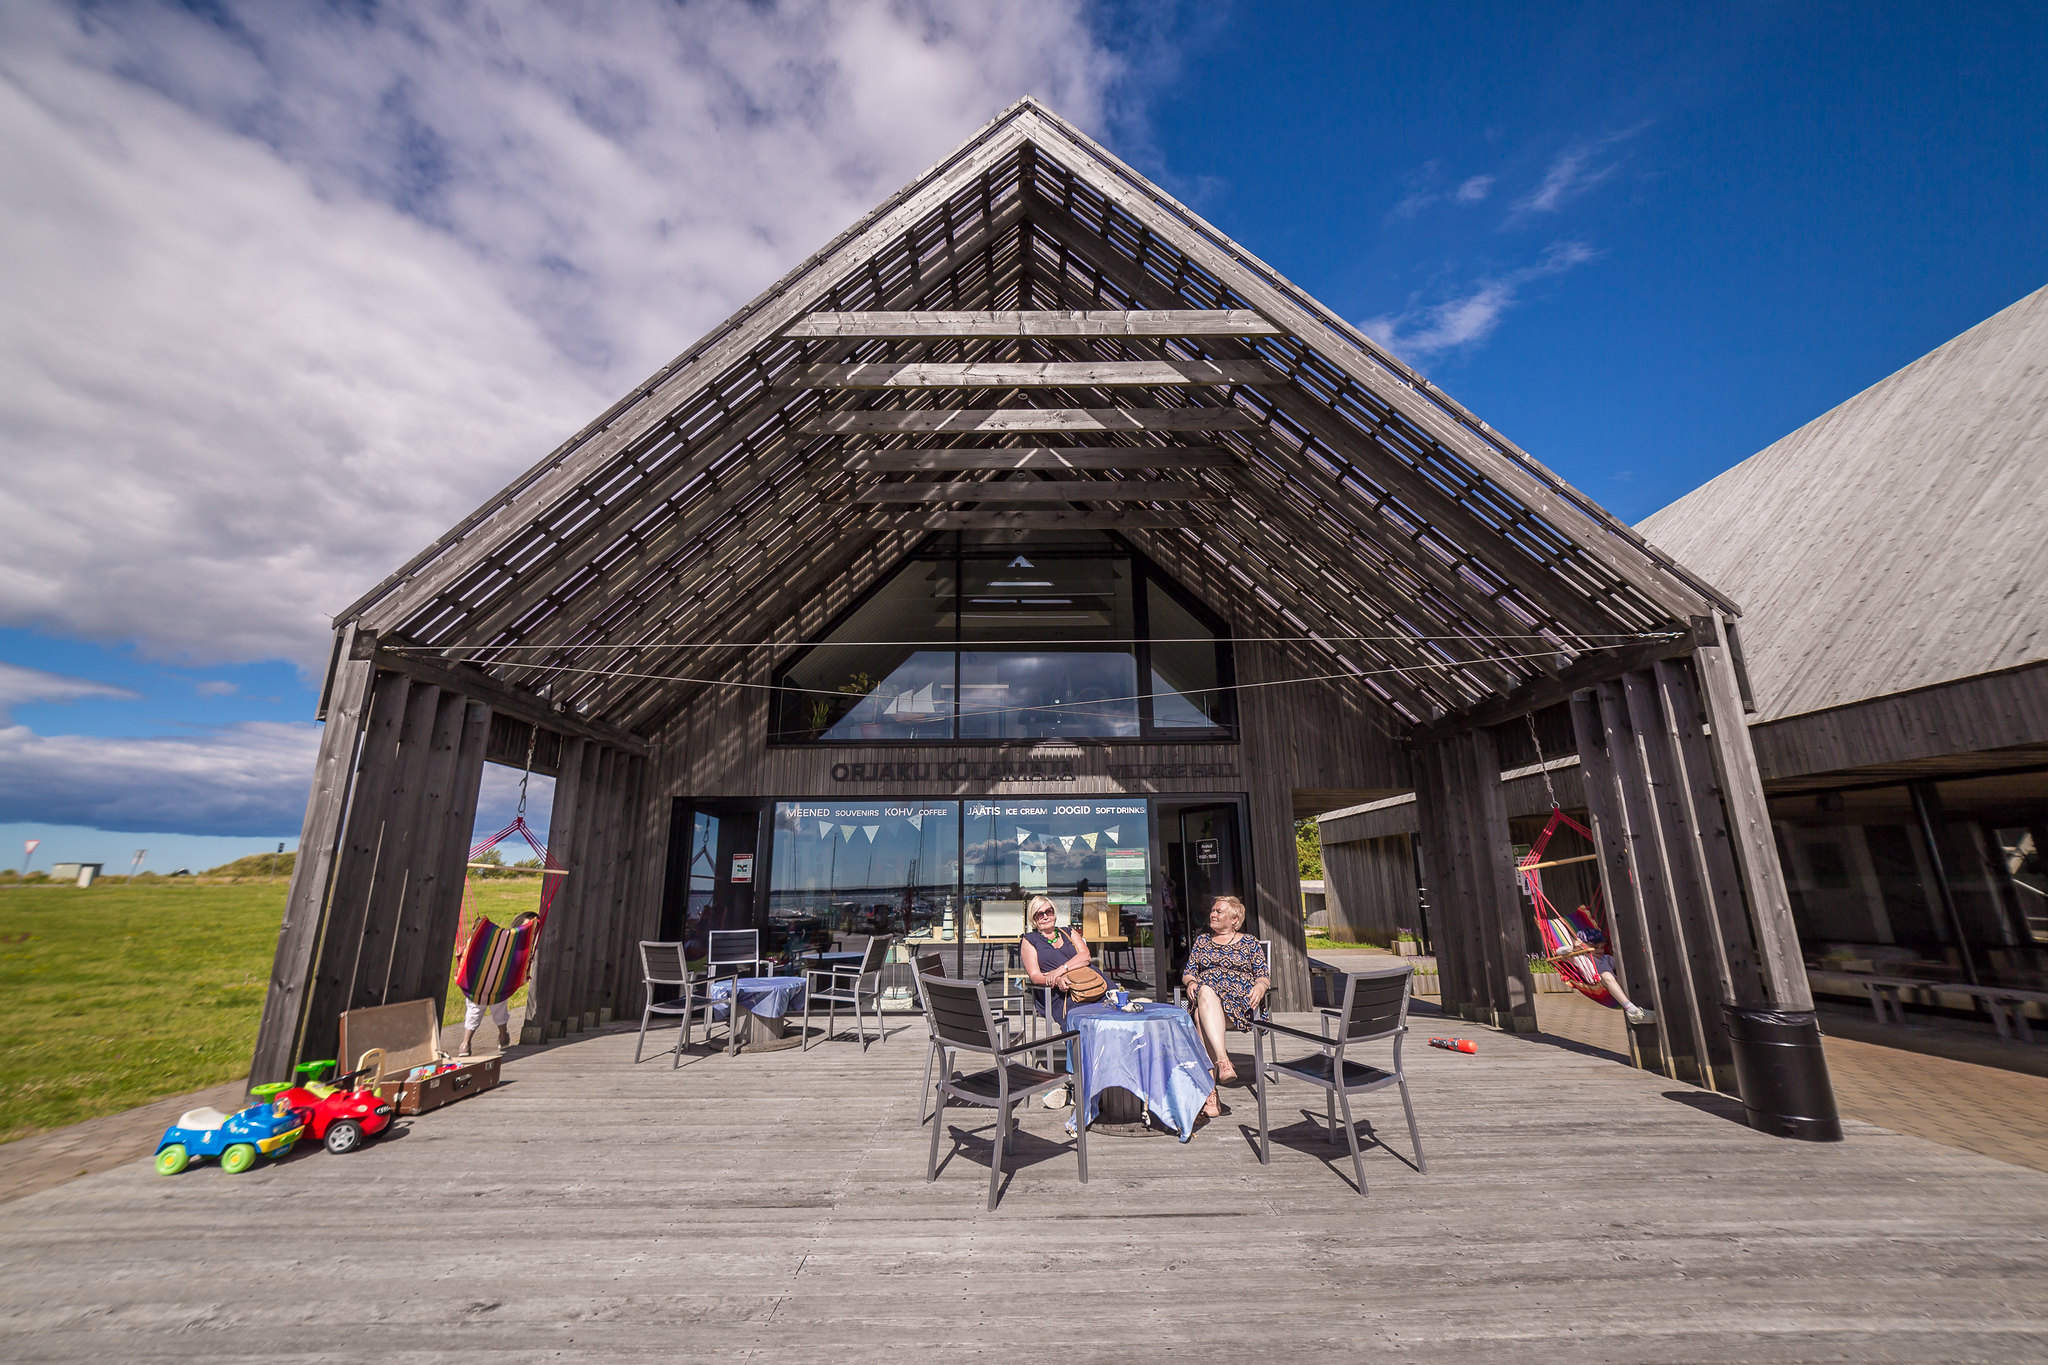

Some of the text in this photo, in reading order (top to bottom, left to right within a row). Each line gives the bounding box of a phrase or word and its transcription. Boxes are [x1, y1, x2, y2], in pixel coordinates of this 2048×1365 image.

[831, 757, 1077, 782] ORJAKU KÜLAMAJA
[1107, 763, 1240, 779] VILLAGE HALL
[786, 808, 831, 817] MEENED
[884, 808, 914, 816] KOHV
[967, 805, 1001, 816] JÄÄTIS
[1005, 808, 1018, 816] ICE
[1053, 806, 1091, 815] JOOGID
